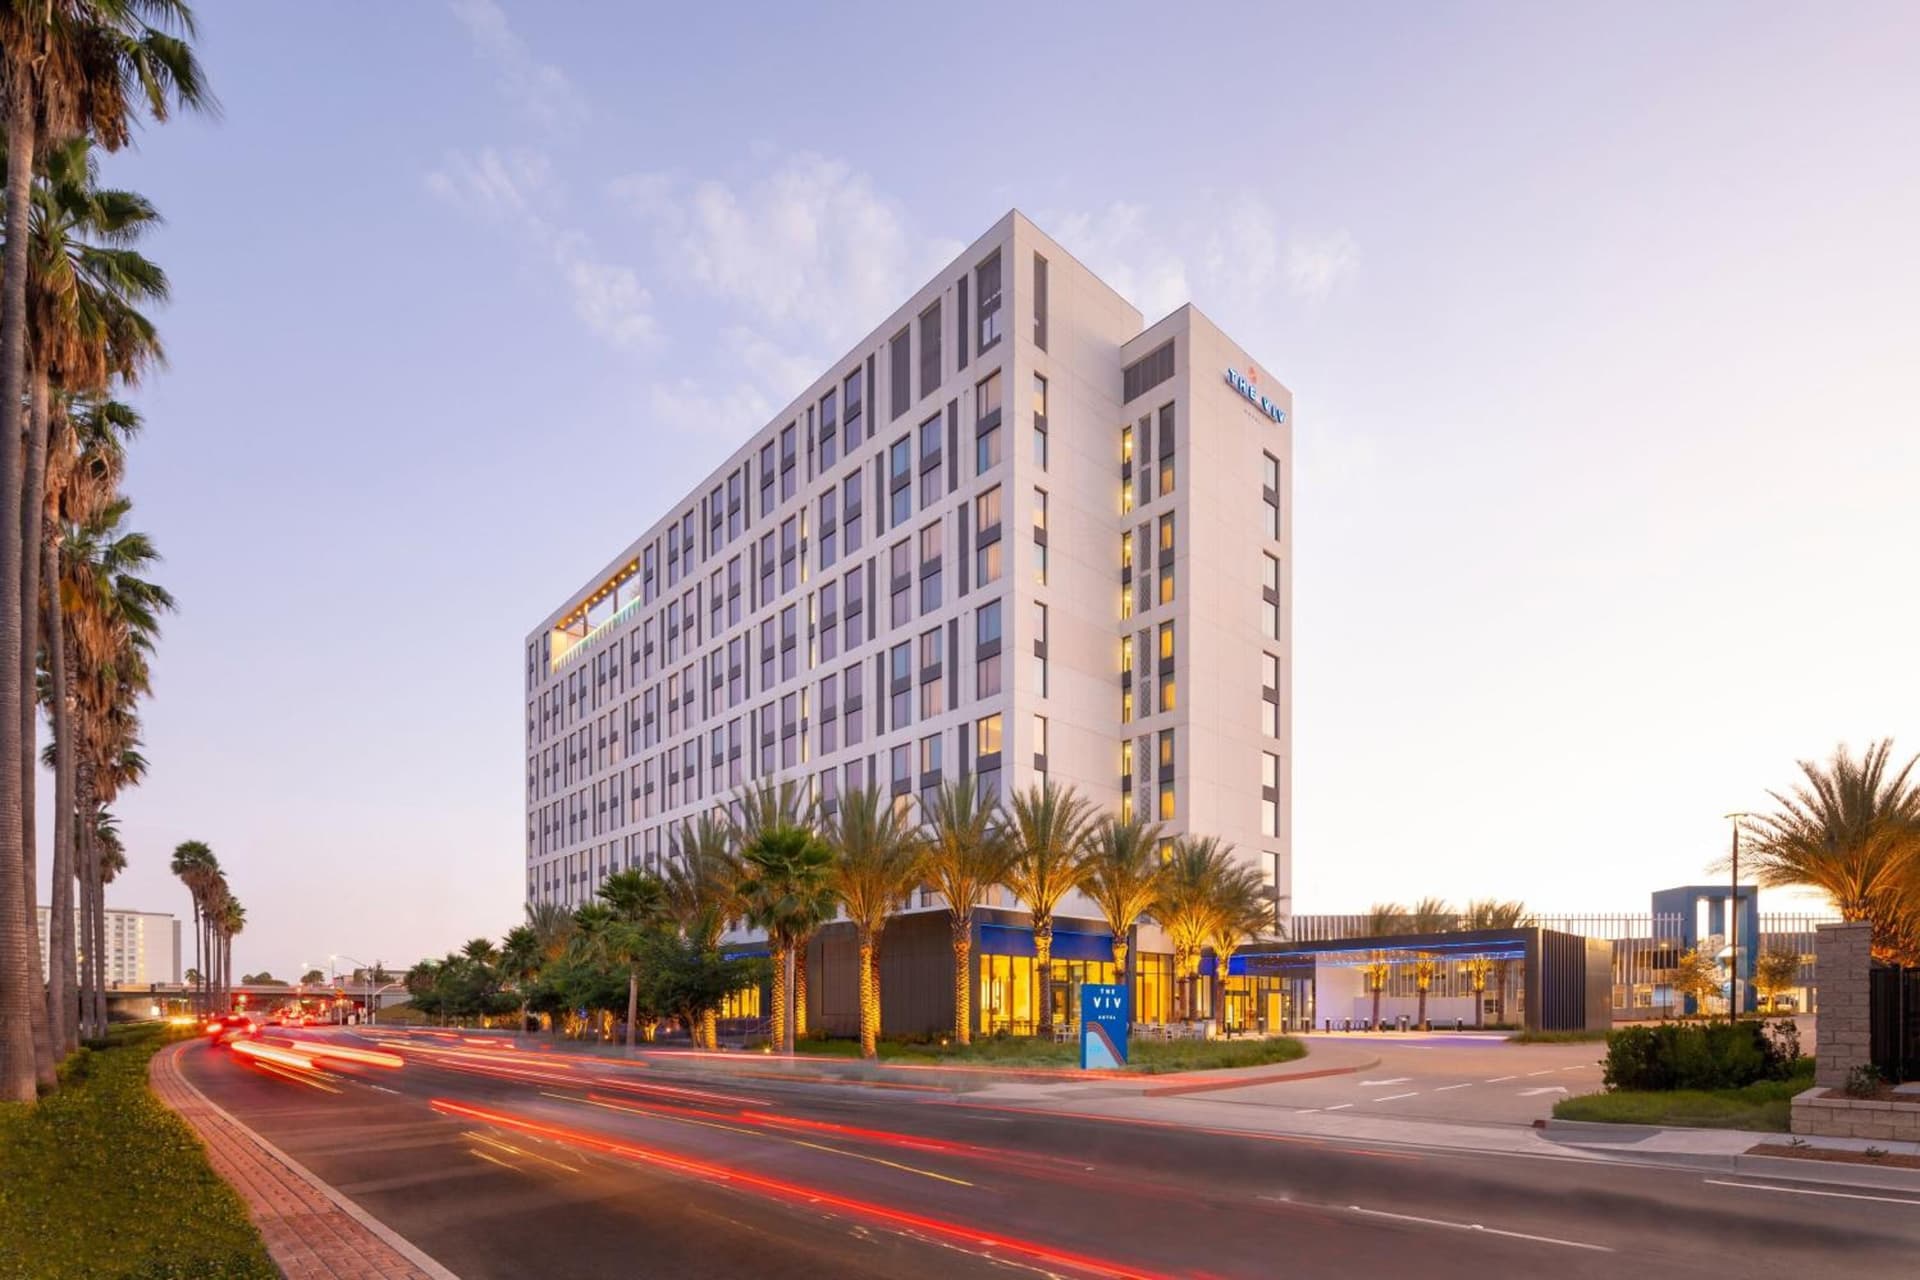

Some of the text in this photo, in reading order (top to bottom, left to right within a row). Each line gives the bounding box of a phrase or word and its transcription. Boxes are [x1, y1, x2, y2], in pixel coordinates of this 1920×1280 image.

[1228, 368, 1257, 401] THE
[1262, 396, 1286, 424] VIV
[1093, 997, 1121, 1008] VIV
